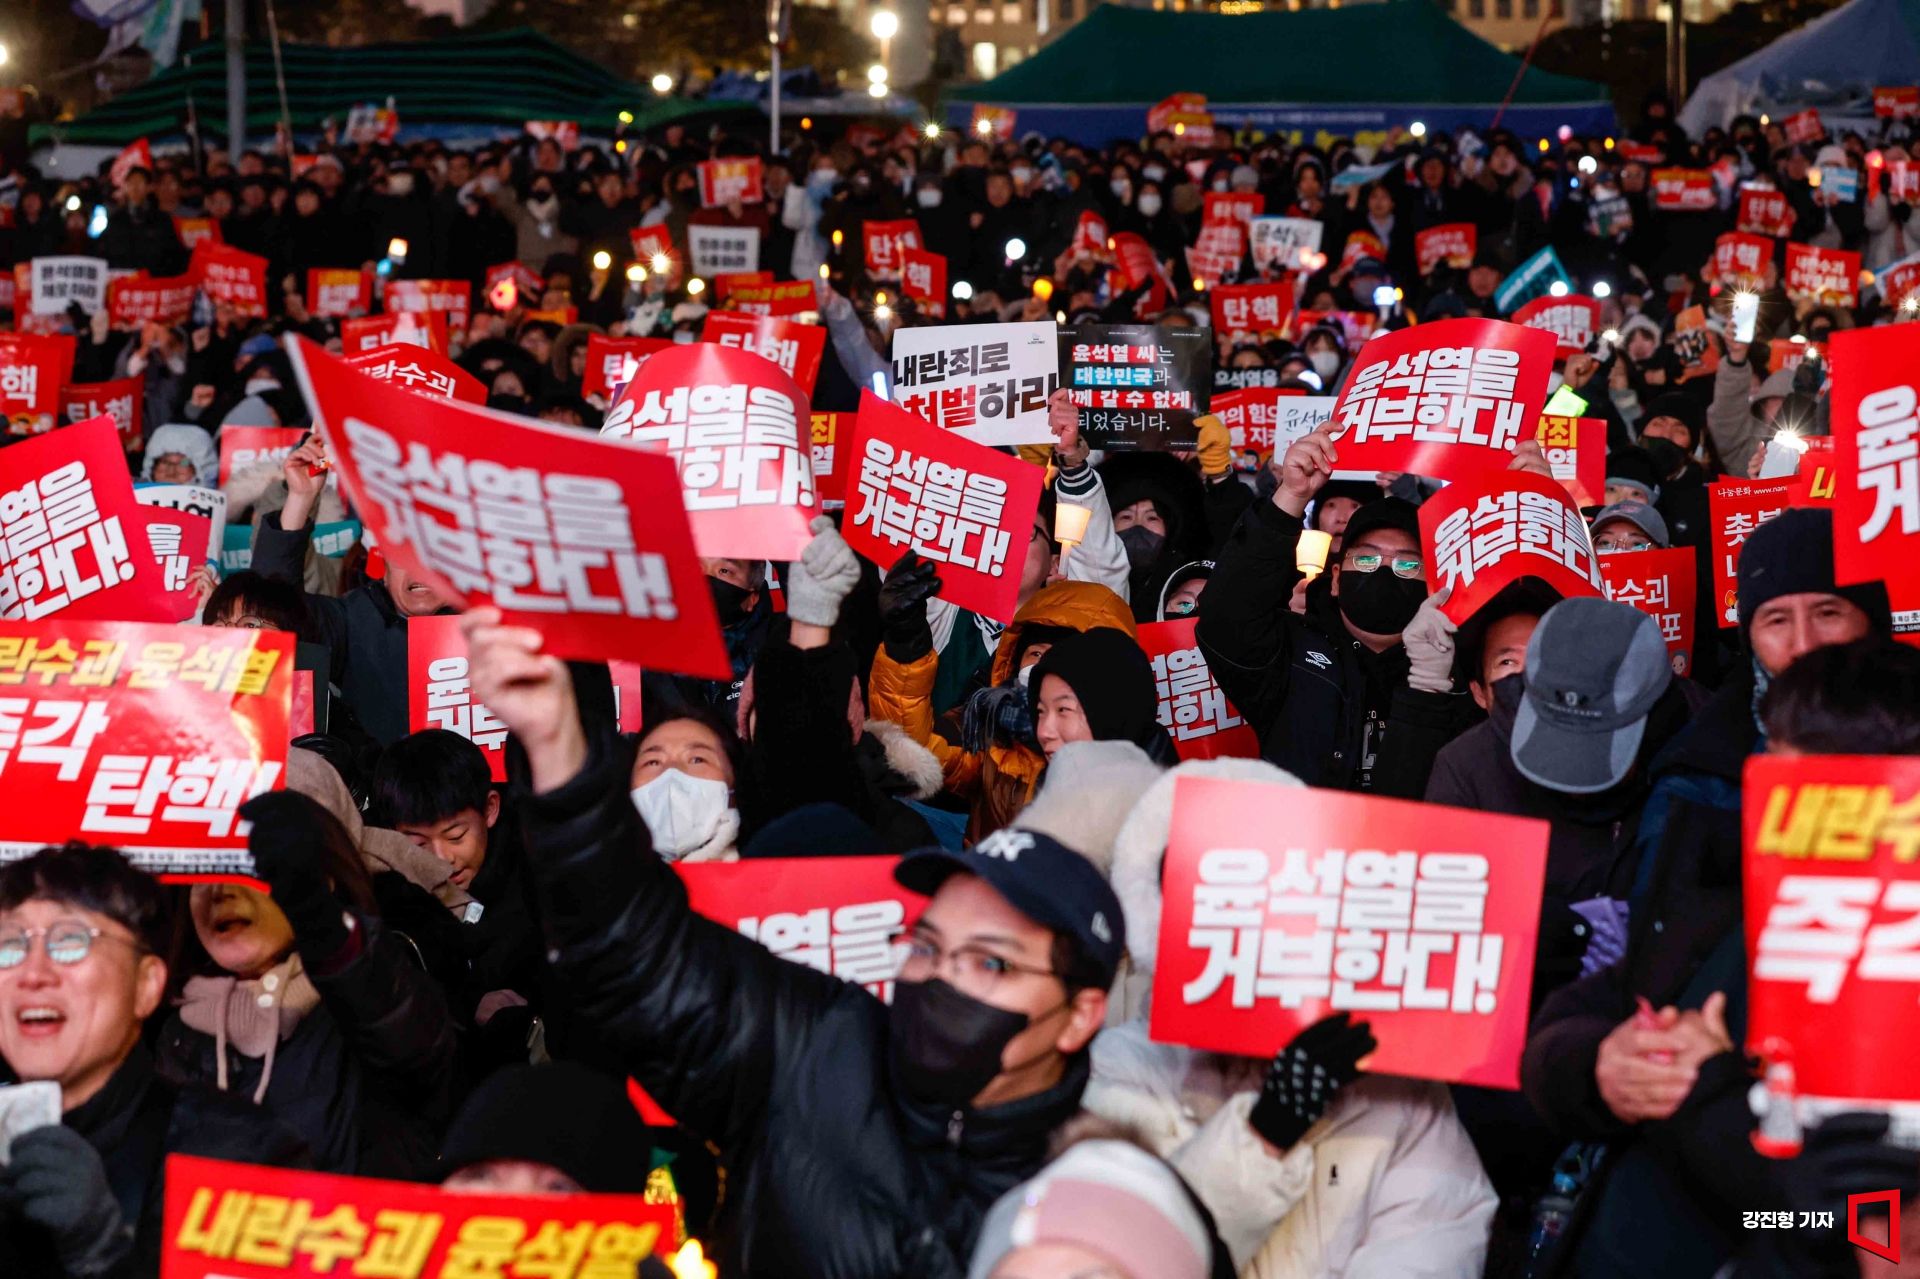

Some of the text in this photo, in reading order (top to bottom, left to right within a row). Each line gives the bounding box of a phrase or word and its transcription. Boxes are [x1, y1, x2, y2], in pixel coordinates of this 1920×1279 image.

[907, 262, 931, 296] 핵
[1717, 243, 1761, 272] 탄핵
[1223, 295, 1279, 326] 탄핵
[603, 352, 651, 388] 탄
[893, 342, 1010, 387] 내란죄로
[1073, 344, 1174, 364] 윤석열 씨는
[1075, 367, 1171, 386] 대한민국과
[1345, 346, 1520, 405] 윤석열을
[1, 364, 38, 409] 핵
[359, 360, 456, 398] 란수괴
[904, 373, 1059, 429] 처벌하라
[1100, 389, 1119, 408] 갈
[1126, 390, 1145, 408] 수
[1152, 390, 1191, 409] 없게
[811, 413, 837, 444] 죄
[1078, 412, 1170, 432] 되었습니다.
[1329, 393, 1525, 451] 거부한다!
[1857, 384, 1920, 471] 윤
[678, 445, 816, 511] 한다!
[812, 445, 835, 475] 열
[859, 437, 1008, 528] 윤석열을
[1543, 448, 1577, 480] 열
[343, 415, 635, 553] 윤석열을
[1718, 486, 1752, 498] 나눔문화
[1857, 457, 1920, 543] 거
[0, 460, 100, 565] 열을
[853, 484, 1011, 578] 거부한다!
[366, 488, 680, 622] 거부한다!
[1649, 612, 1682, 641] 포
[127, 641, 281, 696] 윤석열
[1305, 657, 1326, 670] umbro
[80, 754, 283, 838] 탄핵!
[975, 829, 1036, 862] NY
[1192, 848, 1490, 934] 윤석열을
[737, 899, 905, 985] 열을
[1183, 928, 1504, 1014] 거부한다!
[176, 1187, 445, 1279] 내란수괴
